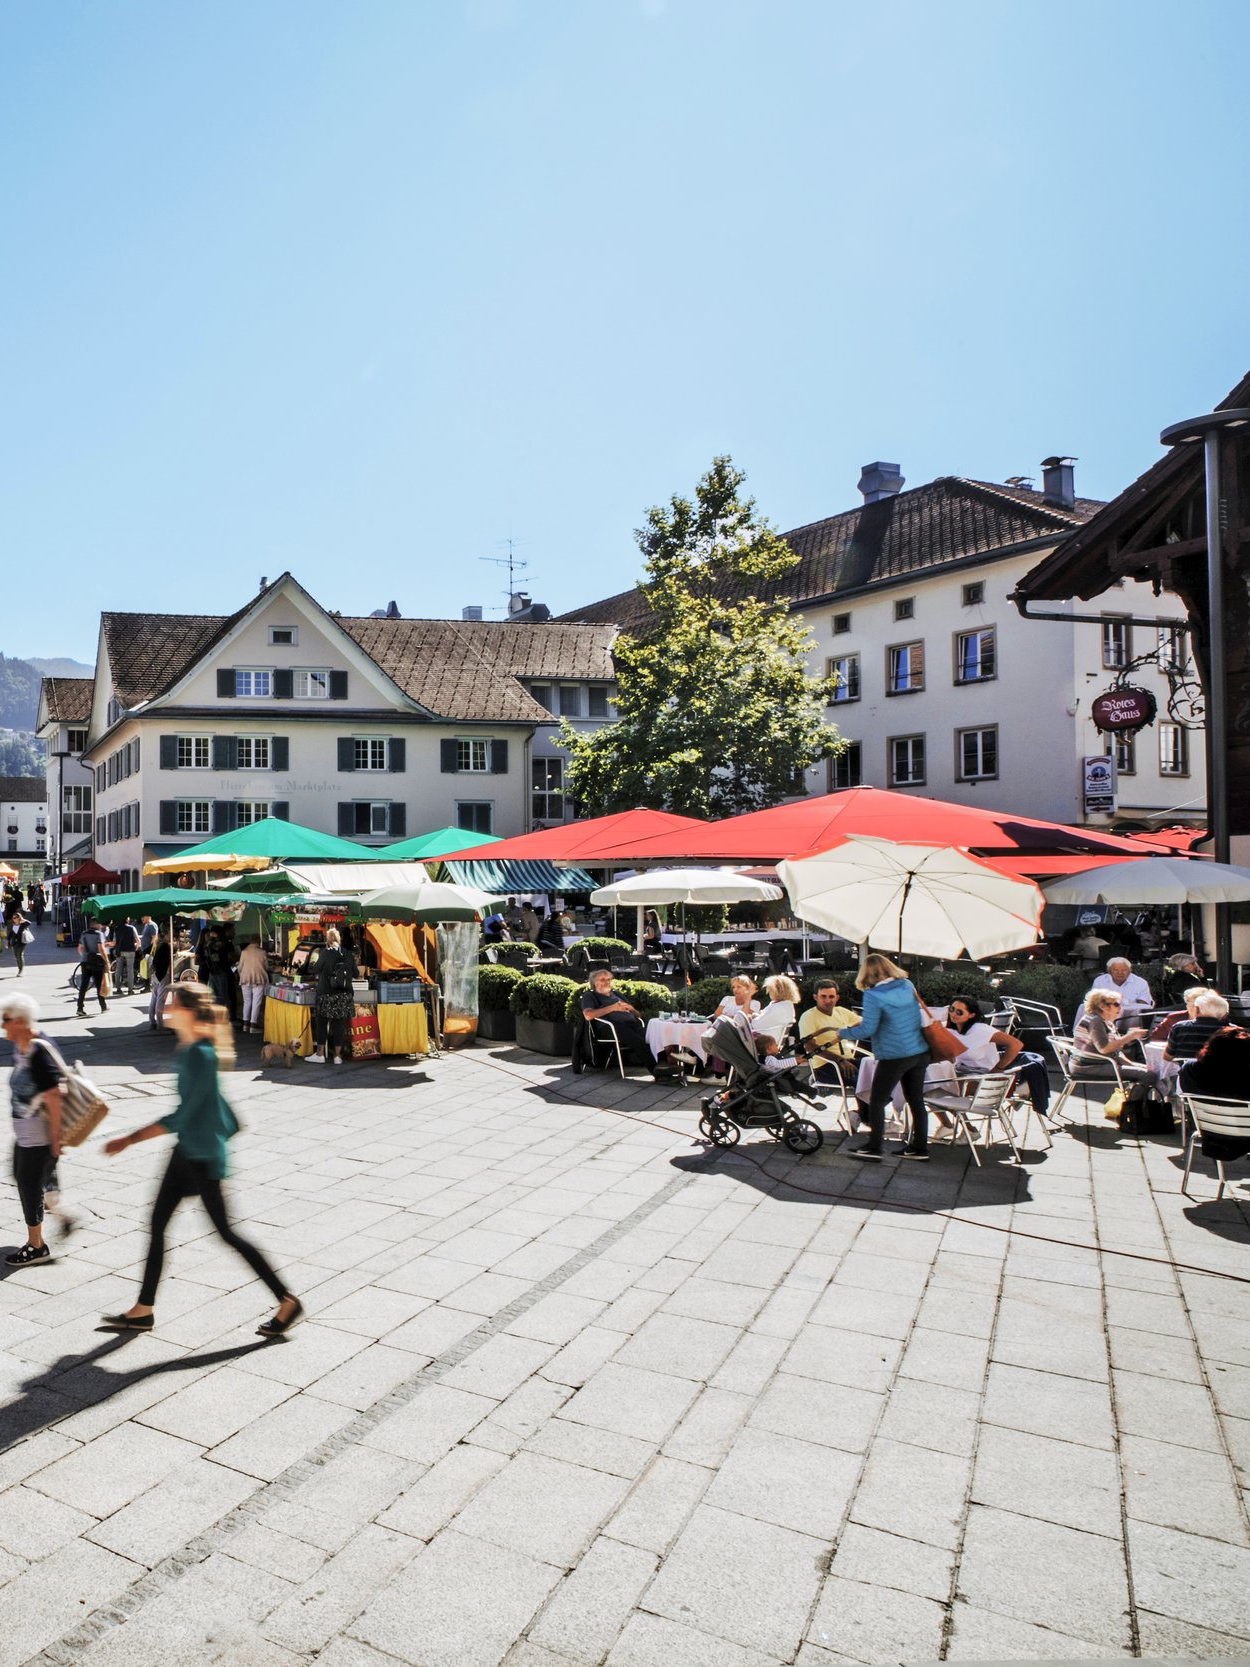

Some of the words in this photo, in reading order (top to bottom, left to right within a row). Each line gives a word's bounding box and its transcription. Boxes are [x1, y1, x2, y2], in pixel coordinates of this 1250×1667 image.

[1101, 699, 1136, 711] Rotes
[1109, 709, 1141, 722] Haus
[286, 780, 342, 792] Marktplatz
